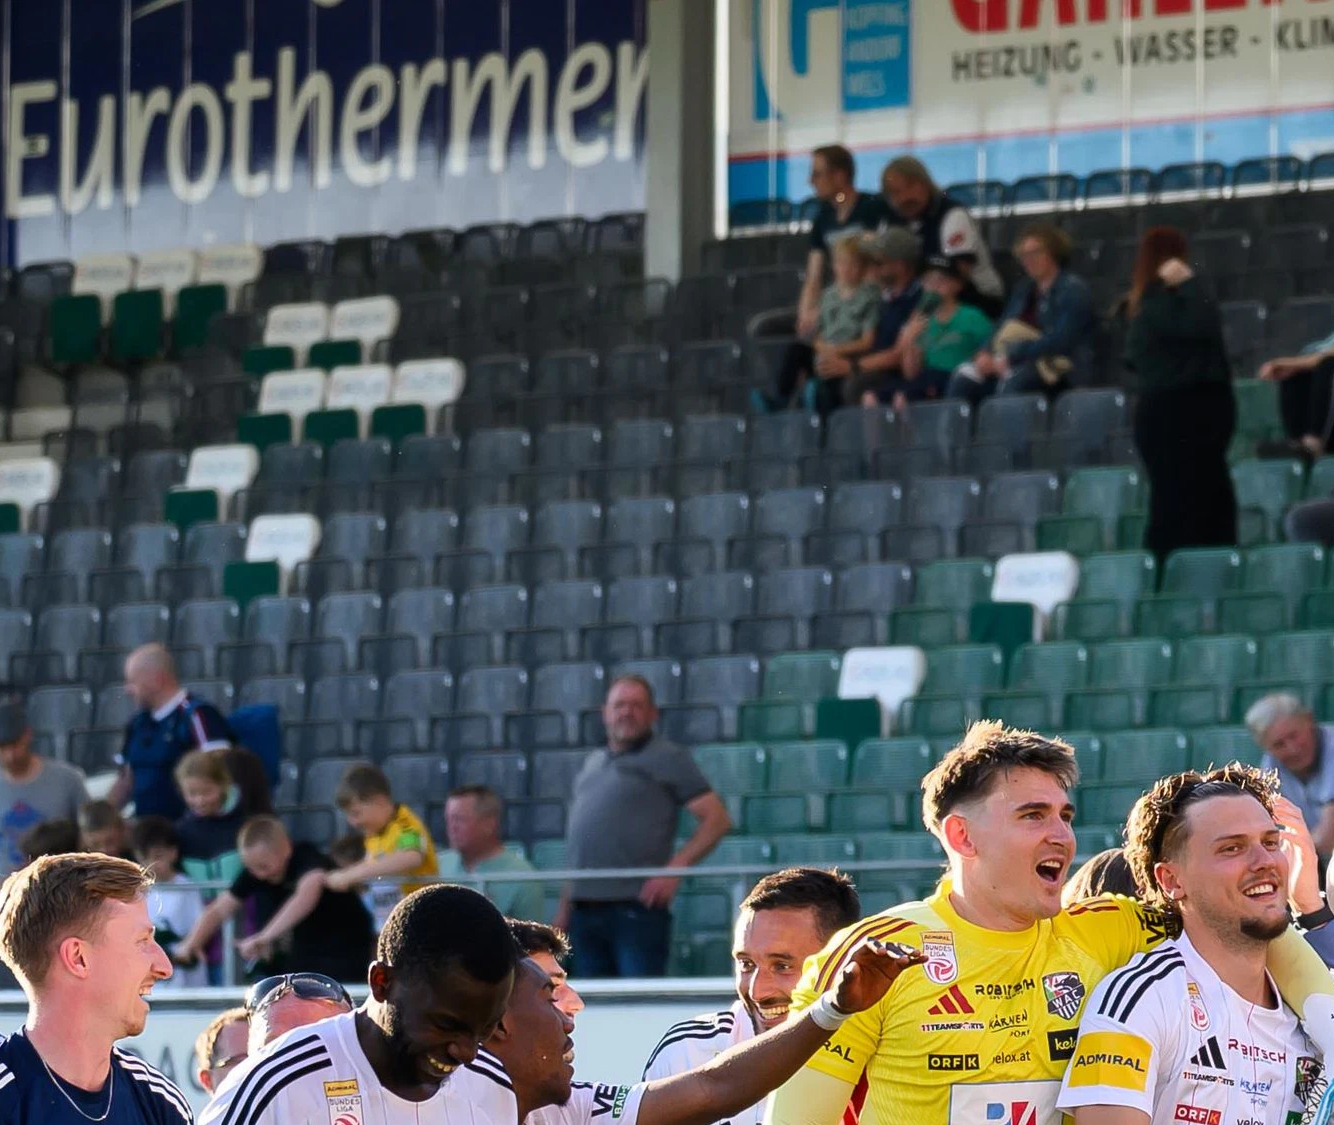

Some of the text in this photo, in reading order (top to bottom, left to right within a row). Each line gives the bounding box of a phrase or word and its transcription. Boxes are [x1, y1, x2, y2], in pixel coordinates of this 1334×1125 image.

[951, 42, 1082, 82] HEIZUNG
[1115, 26, 1239, 66] WASSER
[1052, 989, 1081, 1009] WAC
[930, 1056, 979, 1069] ORF K
[1074, 1052, 1146, 1074] ADMIRAL
[336, 1105, 355, 1113] LIGA
[1177, 1108, 1207, 1121] ORF
